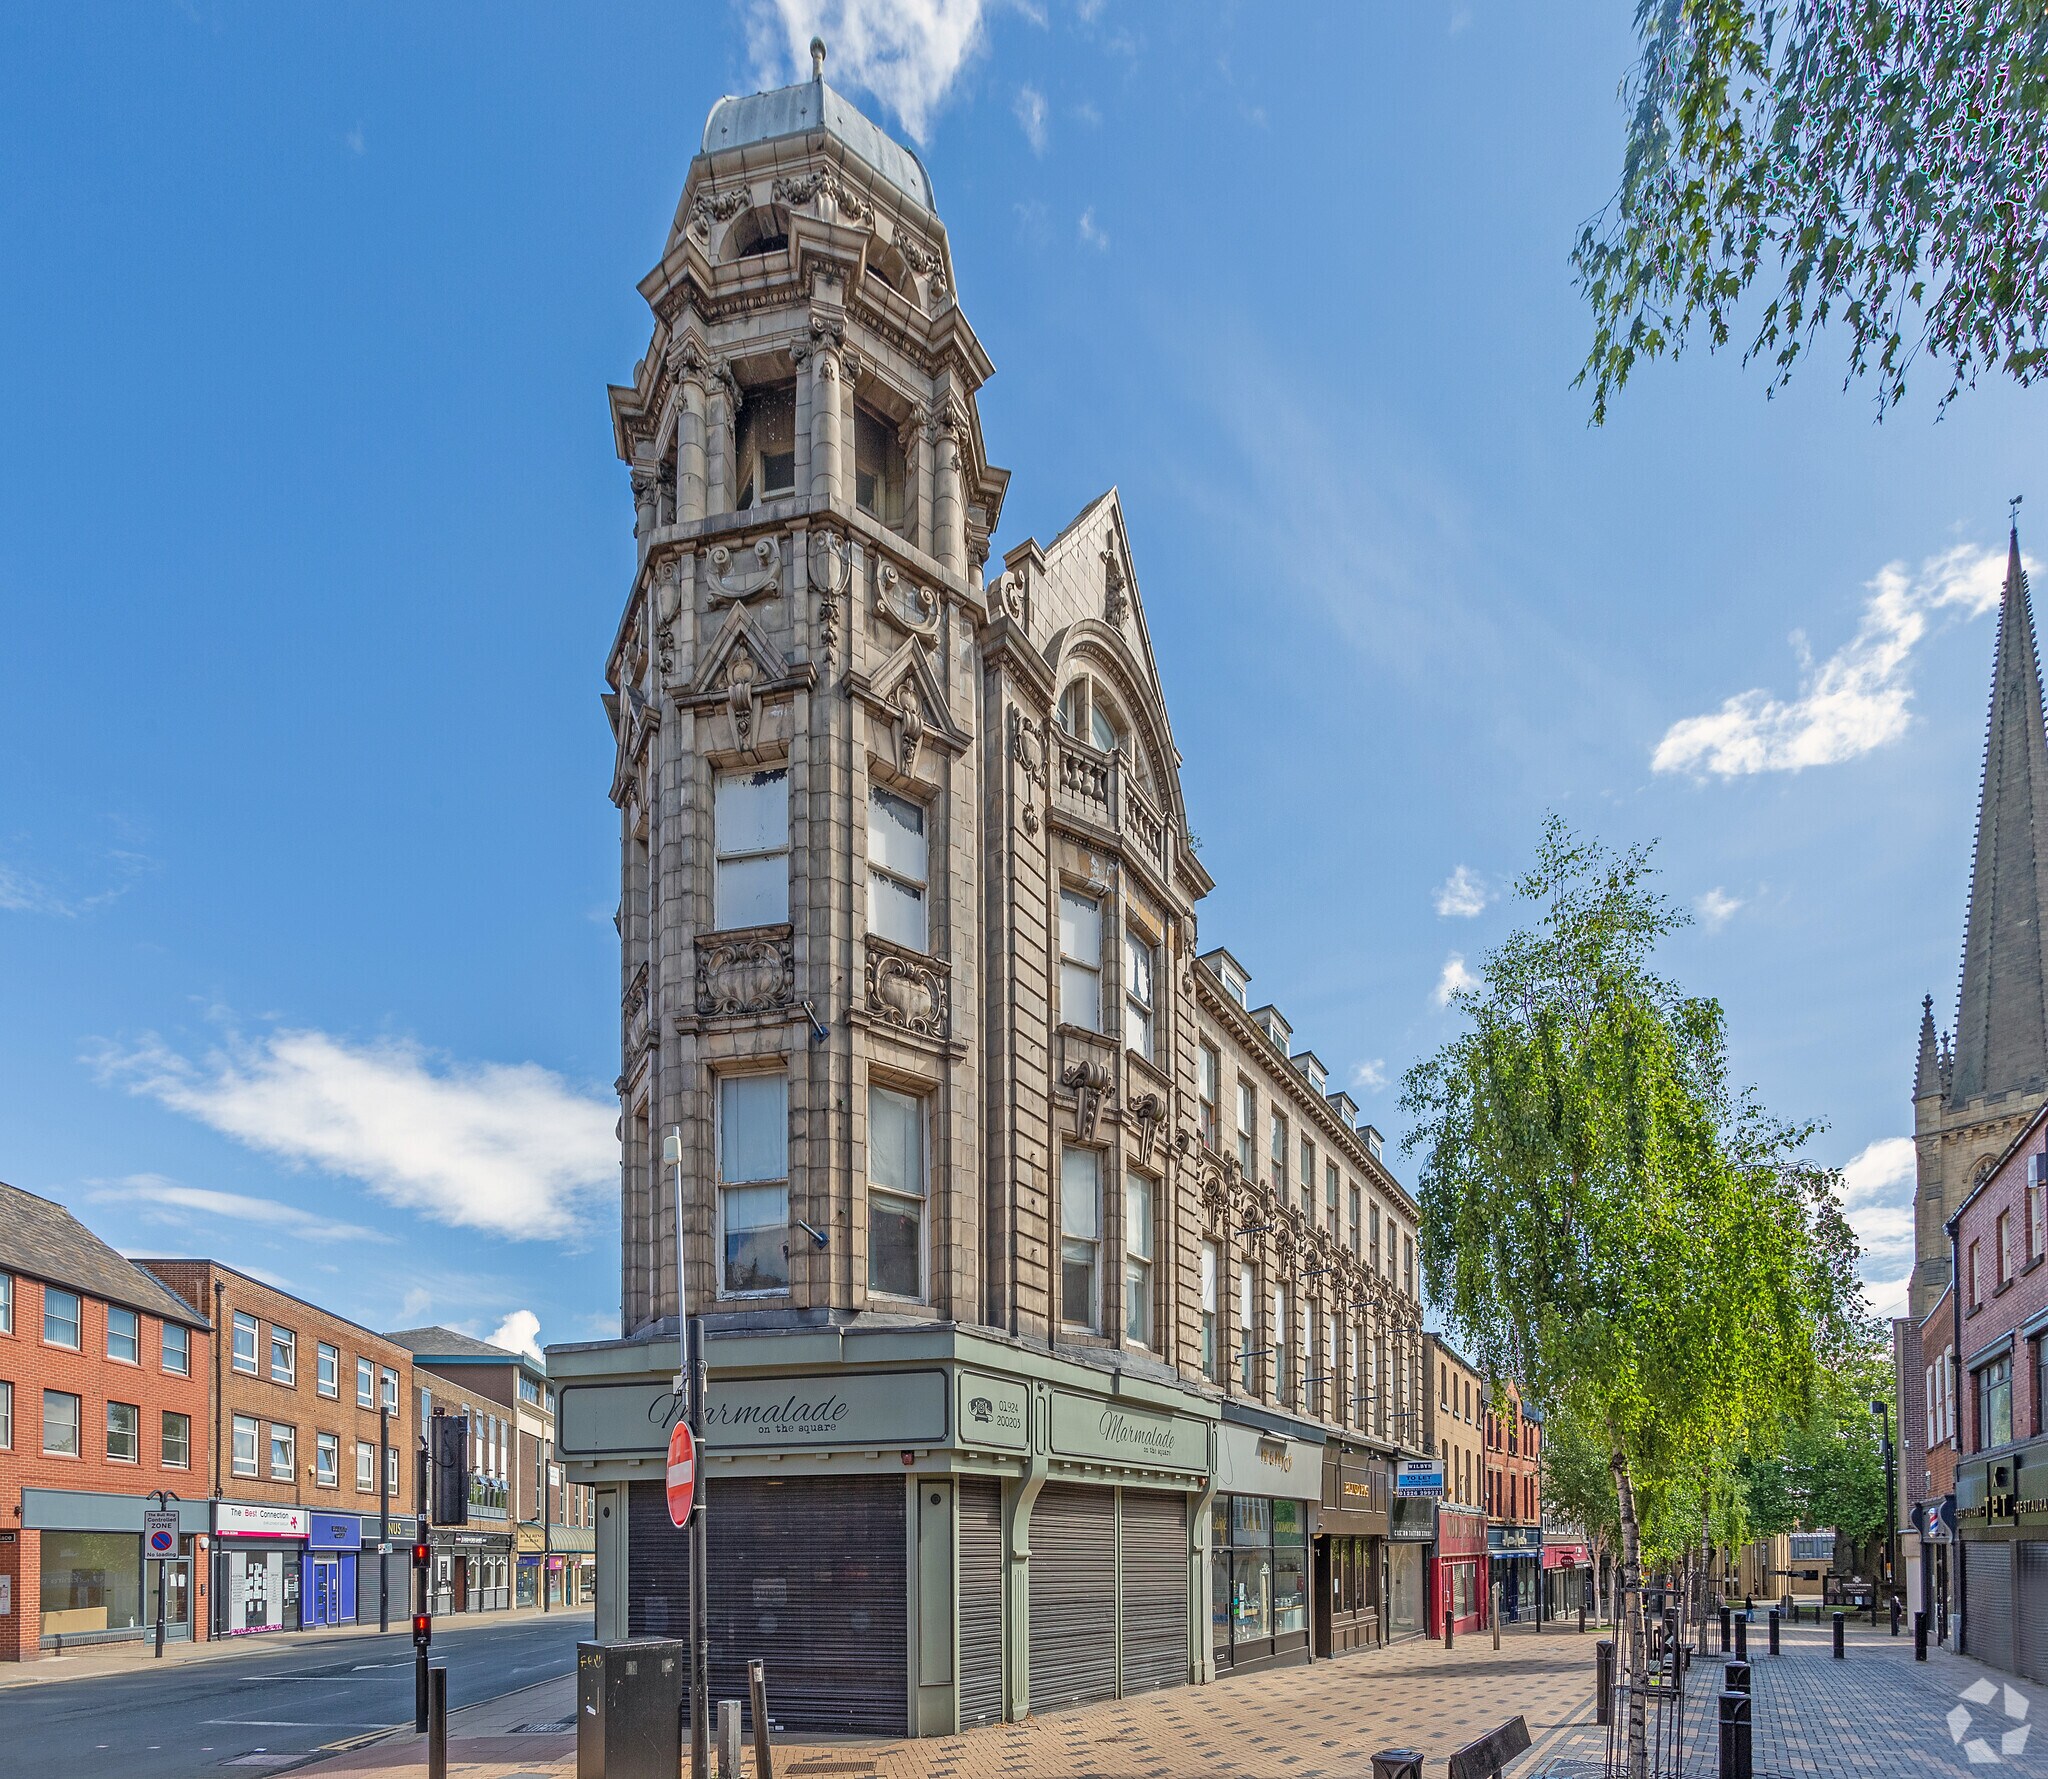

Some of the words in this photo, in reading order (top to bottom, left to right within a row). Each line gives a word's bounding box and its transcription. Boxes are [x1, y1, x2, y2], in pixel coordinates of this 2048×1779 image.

[648, 1394, 850, 1429] Marmalade
[999, 1400, 1018, 1413] 01924
[758, 1426, 770, 1434] on
[775, 1423, 794, 1433] the
[798, 1422, 837, 1434] square
[997, 1415, 1020, 1429] 200203
[1099, 1410, 1175, 1449] Marmalade
[231, 1508, 241, 1516] The
[244, 1509, 257, 1517] Best
[259, 1510, 289, 1519] Connection
